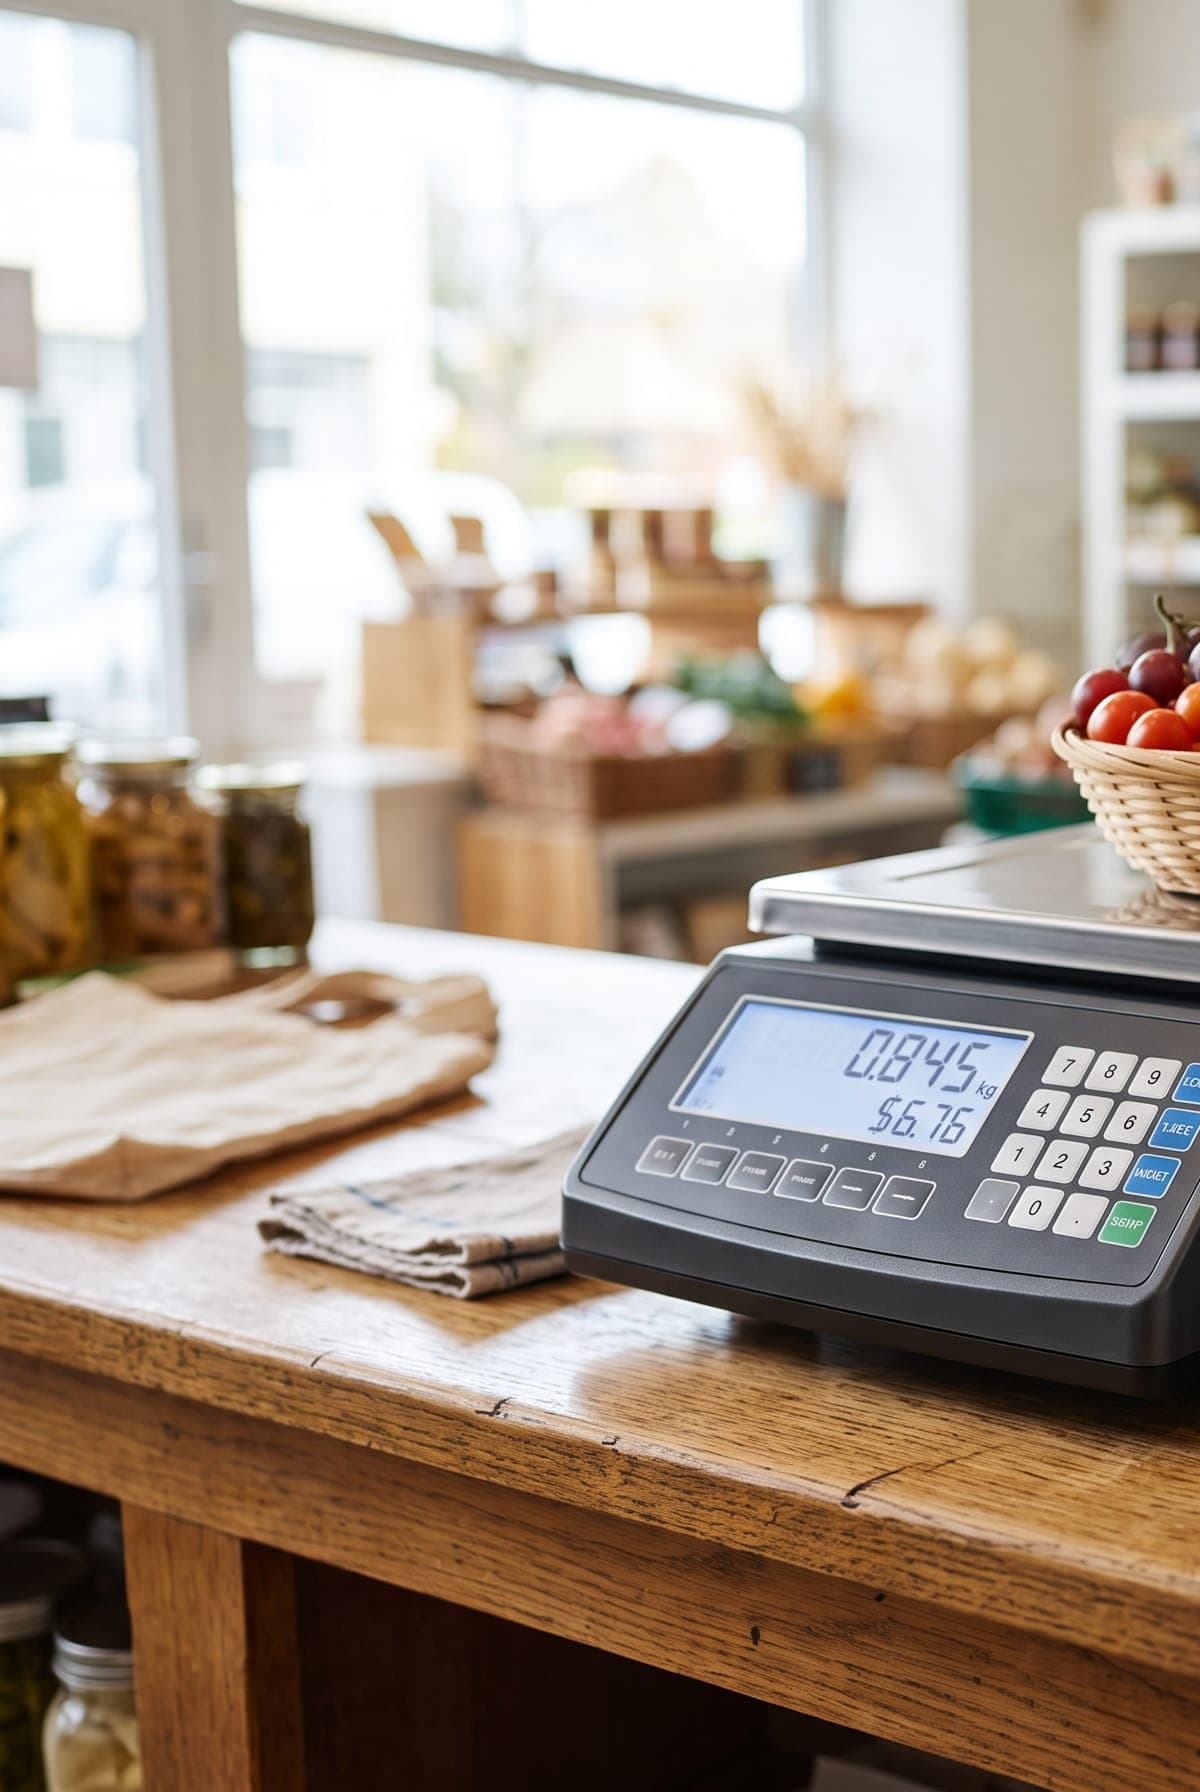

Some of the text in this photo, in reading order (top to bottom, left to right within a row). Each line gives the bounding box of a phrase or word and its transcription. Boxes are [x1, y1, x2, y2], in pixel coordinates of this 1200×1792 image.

[844, 1029, 998, 1100] 0.845 kg
[1062, 1059, 1161, 1085] 7 8 9
[868, 1094, 975, 1144] $6.76
[1036, 1103, 1137, 1130] 4 5 6
[1014, 1146, 1112, 1176] 1 2 3
[1028, 1200, 1042, 1216] 0
